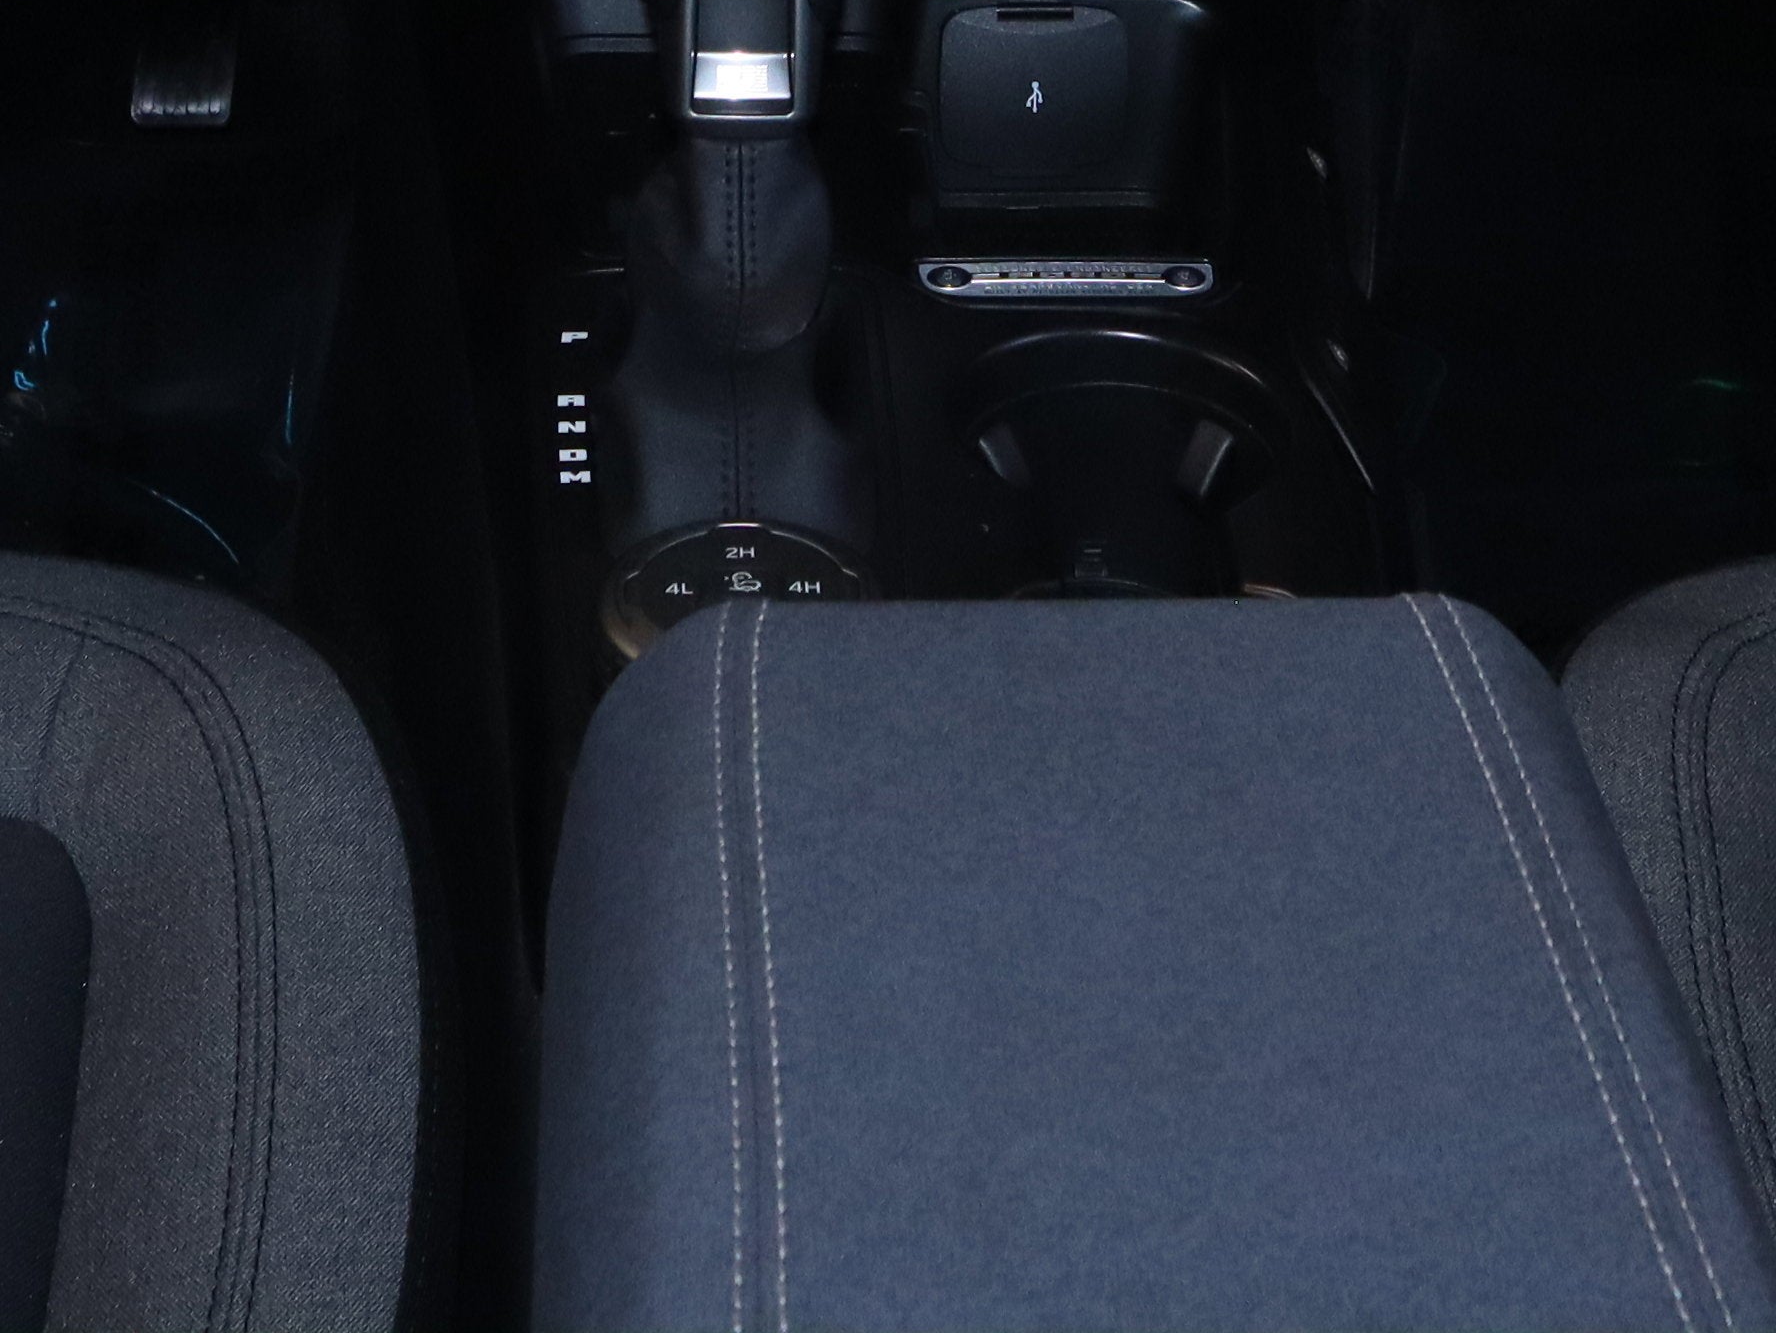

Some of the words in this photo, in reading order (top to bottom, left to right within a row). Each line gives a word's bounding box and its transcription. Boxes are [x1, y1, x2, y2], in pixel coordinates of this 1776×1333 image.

[561, 331, 588, 343] P
[557, 394, 585, 407] R
[558, 421, 586, 433] N
[559, 449, 587, 461] D
[560, 470, 591, 483] M
[725, 546, 755, 559] 2H
[665, 582, 693, 595] 4L
[788, 581, 821, 594] 4H
